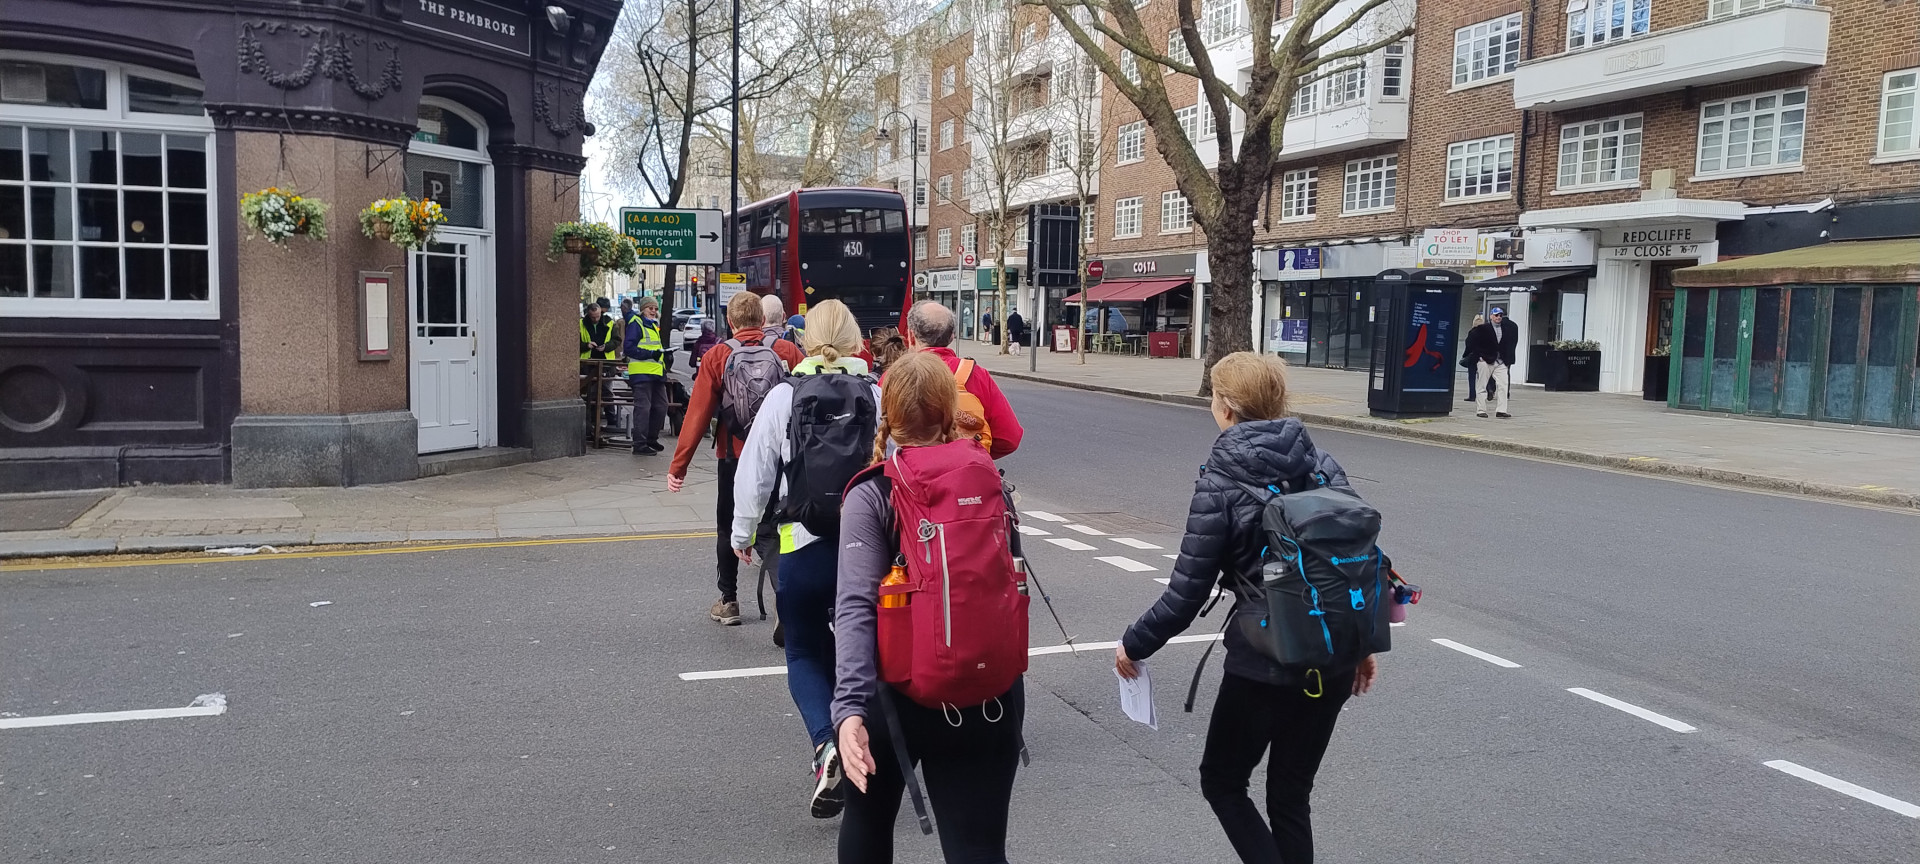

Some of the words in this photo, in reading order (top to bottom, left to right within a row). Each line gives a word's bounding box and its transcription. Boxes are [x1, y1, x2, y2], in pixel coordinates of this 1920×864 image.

[419, 0, 445, 16] THE
[450, 8, 516, 36] PEMBROKE
[430, 180, 443, 200] P
[653, 214, 680, 225] A40)
[628, 227, 694, 237] Hammersmith
[1622, 228, 1692, 243] REDCLIFFE
[655, 237, 683, 247] Court
[844, 241, 863, 256] 430
[1614, 248, 1628, 256] 1-27
[1634, 245, 1672, 257] CLOSE
[1133, 261, 1157, 274] COSTA
[1339, 554, 1370, 564] MONTANE
